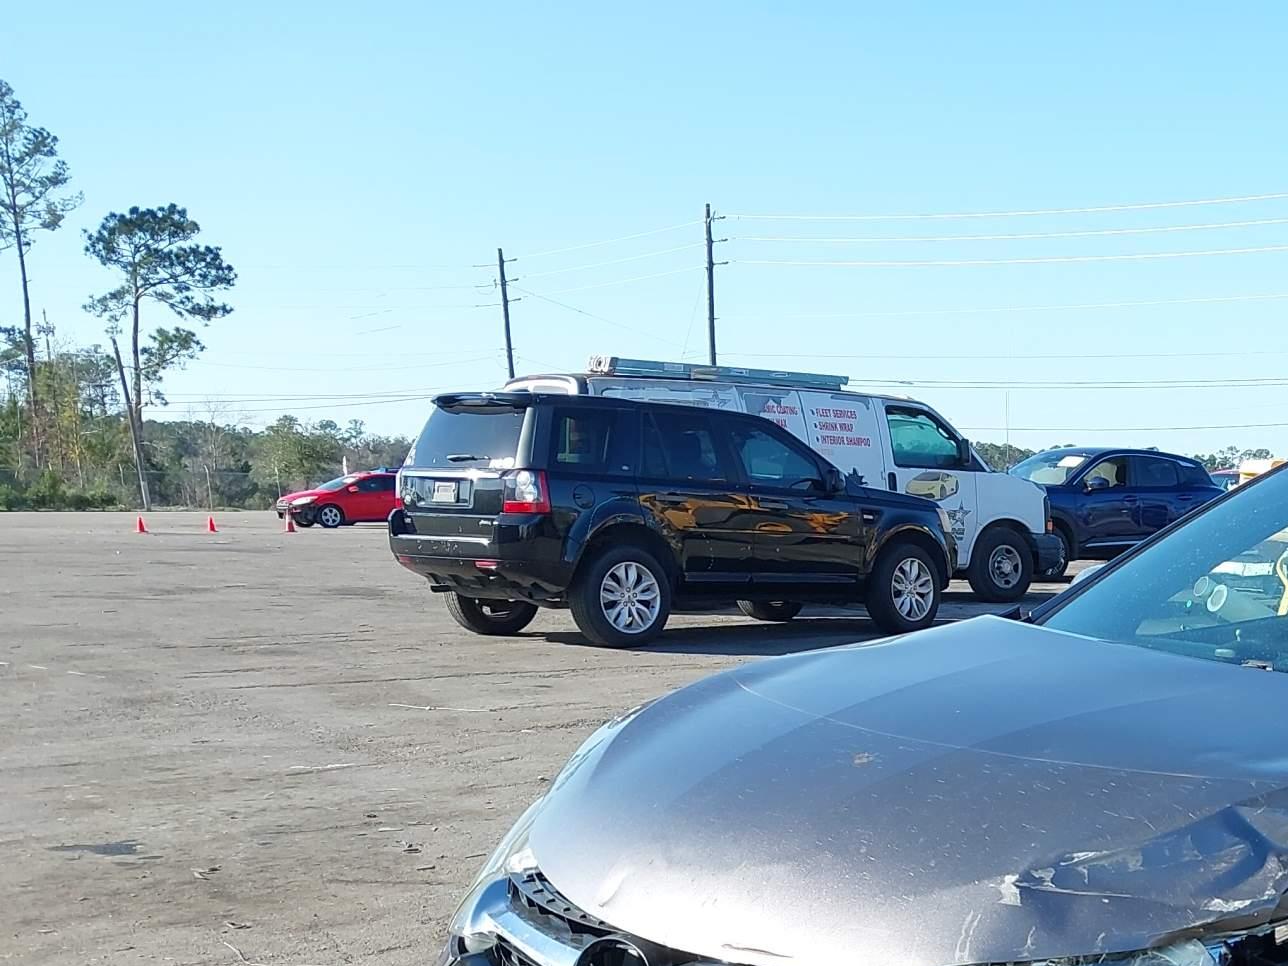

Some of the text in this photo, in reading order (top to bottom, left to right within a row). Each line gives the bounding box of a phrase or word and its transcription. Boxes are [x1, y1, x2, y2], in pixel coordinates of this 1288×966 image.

[816, 408, 857, 420] FLEET SERVICES
[818, 421, 853, 433] SHRINK WRAP
[820, 435, 870, 447] INTERIOR SHAMPOO
